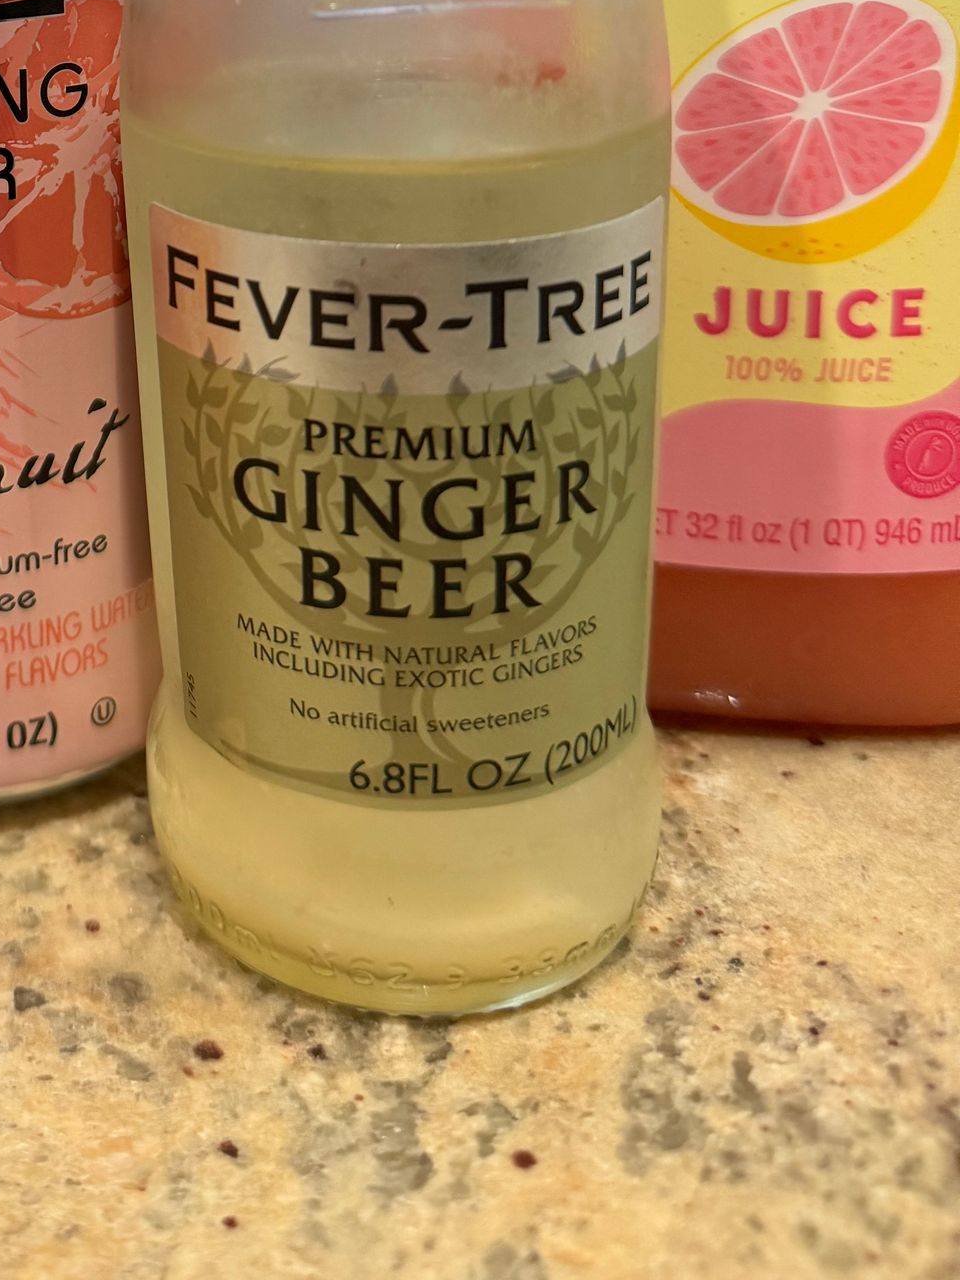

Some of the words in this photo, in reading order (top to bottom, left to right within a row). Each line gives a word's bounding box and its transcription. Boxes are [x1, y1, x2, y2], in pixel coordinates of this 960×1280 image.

[166, 245, 653, 354] FEVER-TREE
[693, 286, 924, 339] JUICE
[725, 354, 803, 383] 100%
[815, 357, 892, 383] JUICE
[303, 418, 537, 461] PREMIUM
[233, 458, 598, 543] GINGER
[685, 511, 719, 540] 32
[726, 514, 743, 542] fl
[751, 521, 783, 544] oz
[790, 517, 810, 552] (1
[823, 517, 866, 551] QT)
[875, 518, 922, 545] 946
[299, 547, 541, 619] BEER
[5, 638, 110, 691] FLAVORS
[237, 613, 302, 649] MADE
[310, 634, 373, 662] WITH
[383, 643, 501, 666] NATURAL
[510, 615, 598, 658] FLAVORS
[253, 641, 386, 687] INCLUDING
[395, 668, 485, 689] EXOTIC
[492, 644, 584, 684] GINGERS
[6, 711, 58, 749] OZ)
[289, 697, 321, 721] No
[327, 710, 419, 734] artificial
[426, 703, 551, 734] sweeteners
[348, 758, 452, 796] 6.8FL
[467, 752, 532, 789] OZ
[544, 694, 638, 785] (200ML)
